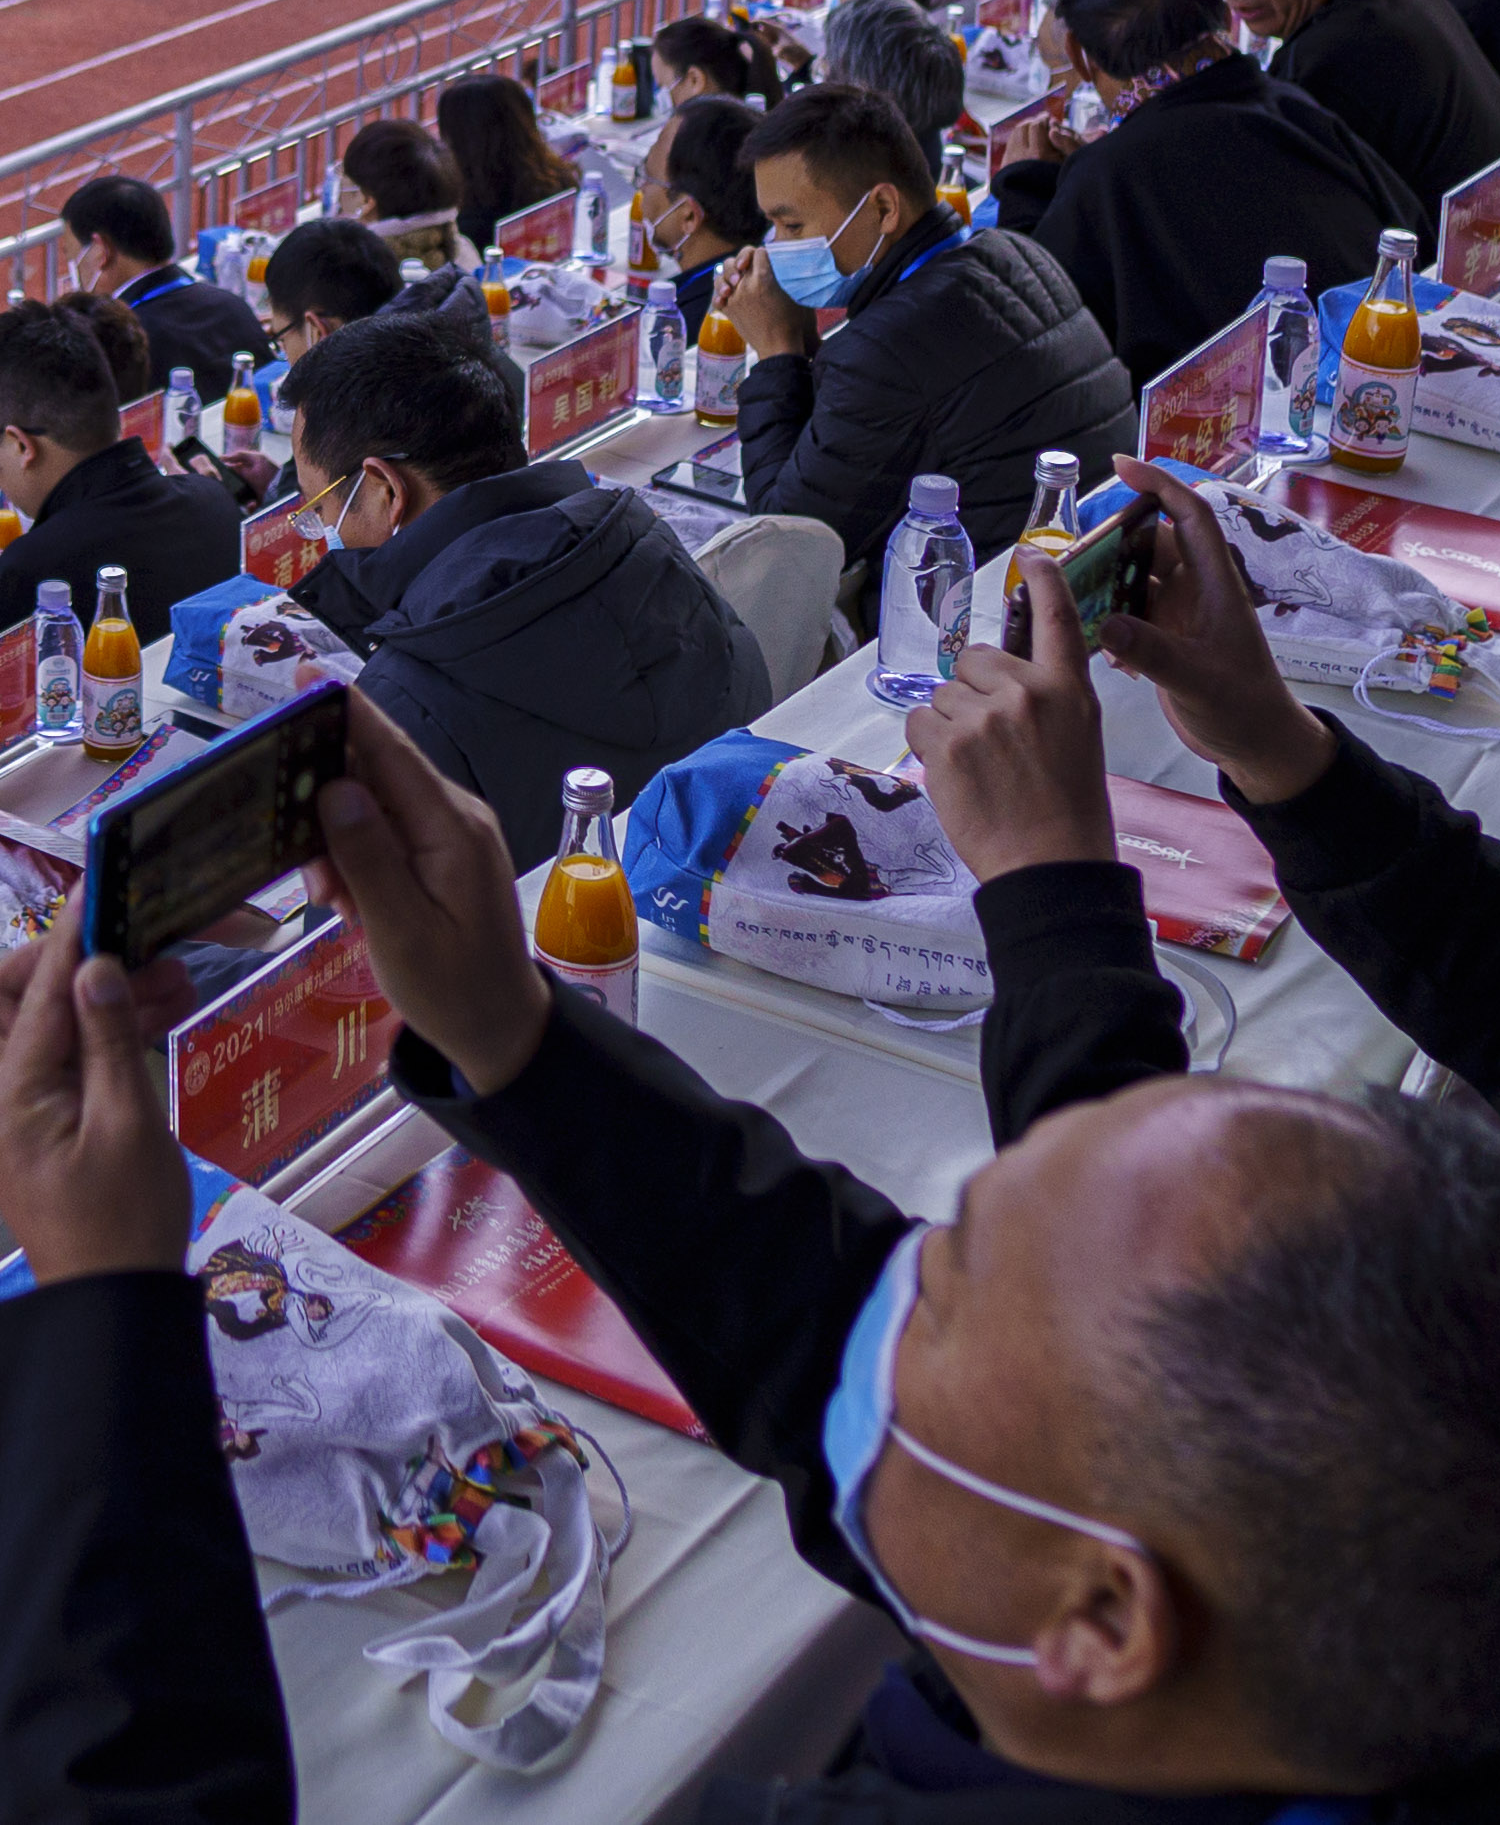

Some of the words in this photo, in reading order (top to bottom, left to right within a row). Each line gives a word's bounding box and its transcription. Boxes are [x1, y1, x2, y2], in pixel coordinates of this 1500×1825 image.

[552, 368, 618, 430] 吴国利
[1163, 386, 1189, 424] 2021
[263, 520, 290, 548] 2021
[213, 1012, 264, 1076] 2021
[242, 999, 367, 1150] 蒲川
